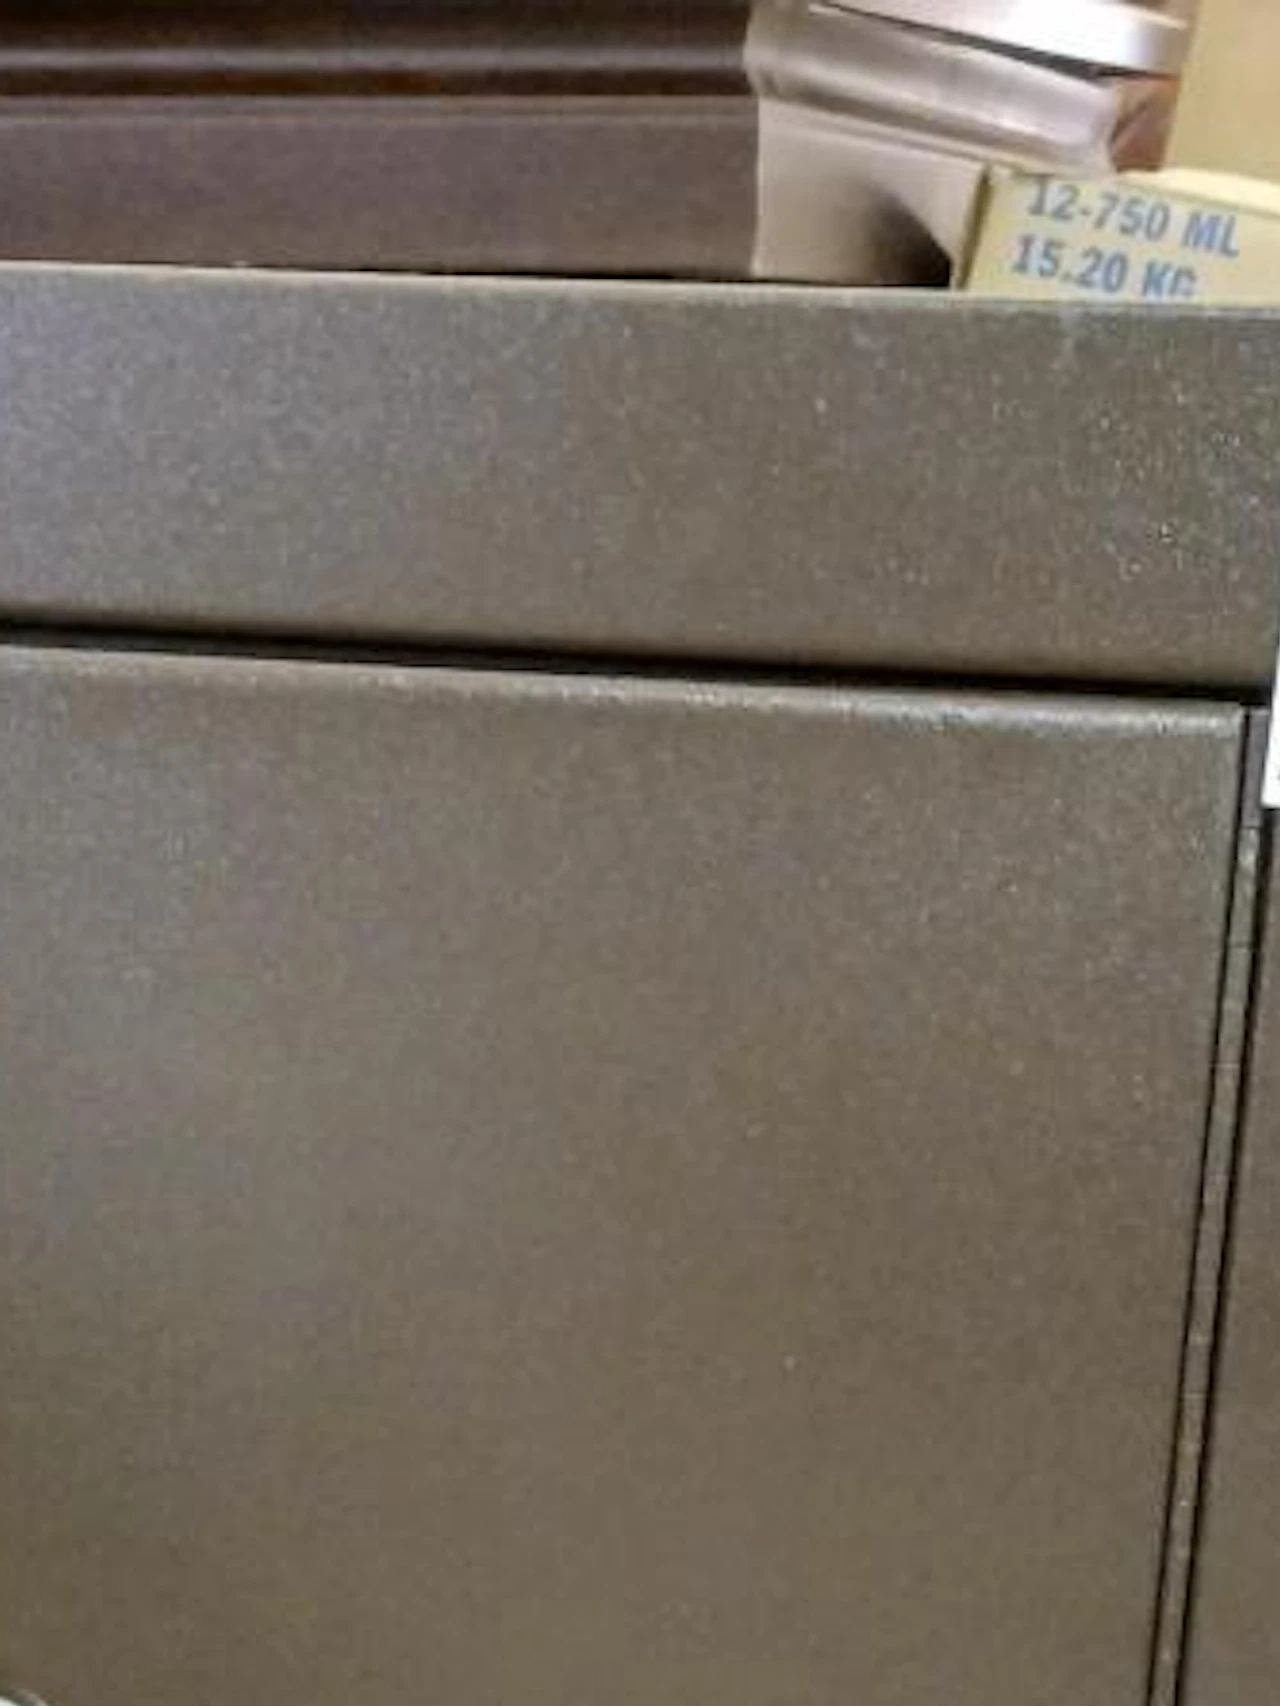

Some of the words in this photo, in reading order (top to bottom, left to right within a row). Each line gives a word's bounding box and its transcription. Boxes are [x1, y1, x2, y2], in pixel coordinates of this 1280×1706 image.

[1026, 174, 1171, 241] 12-750
[1182, 210, 1240, 258] ML
[1012, 233, 1130, 293] 15.20
